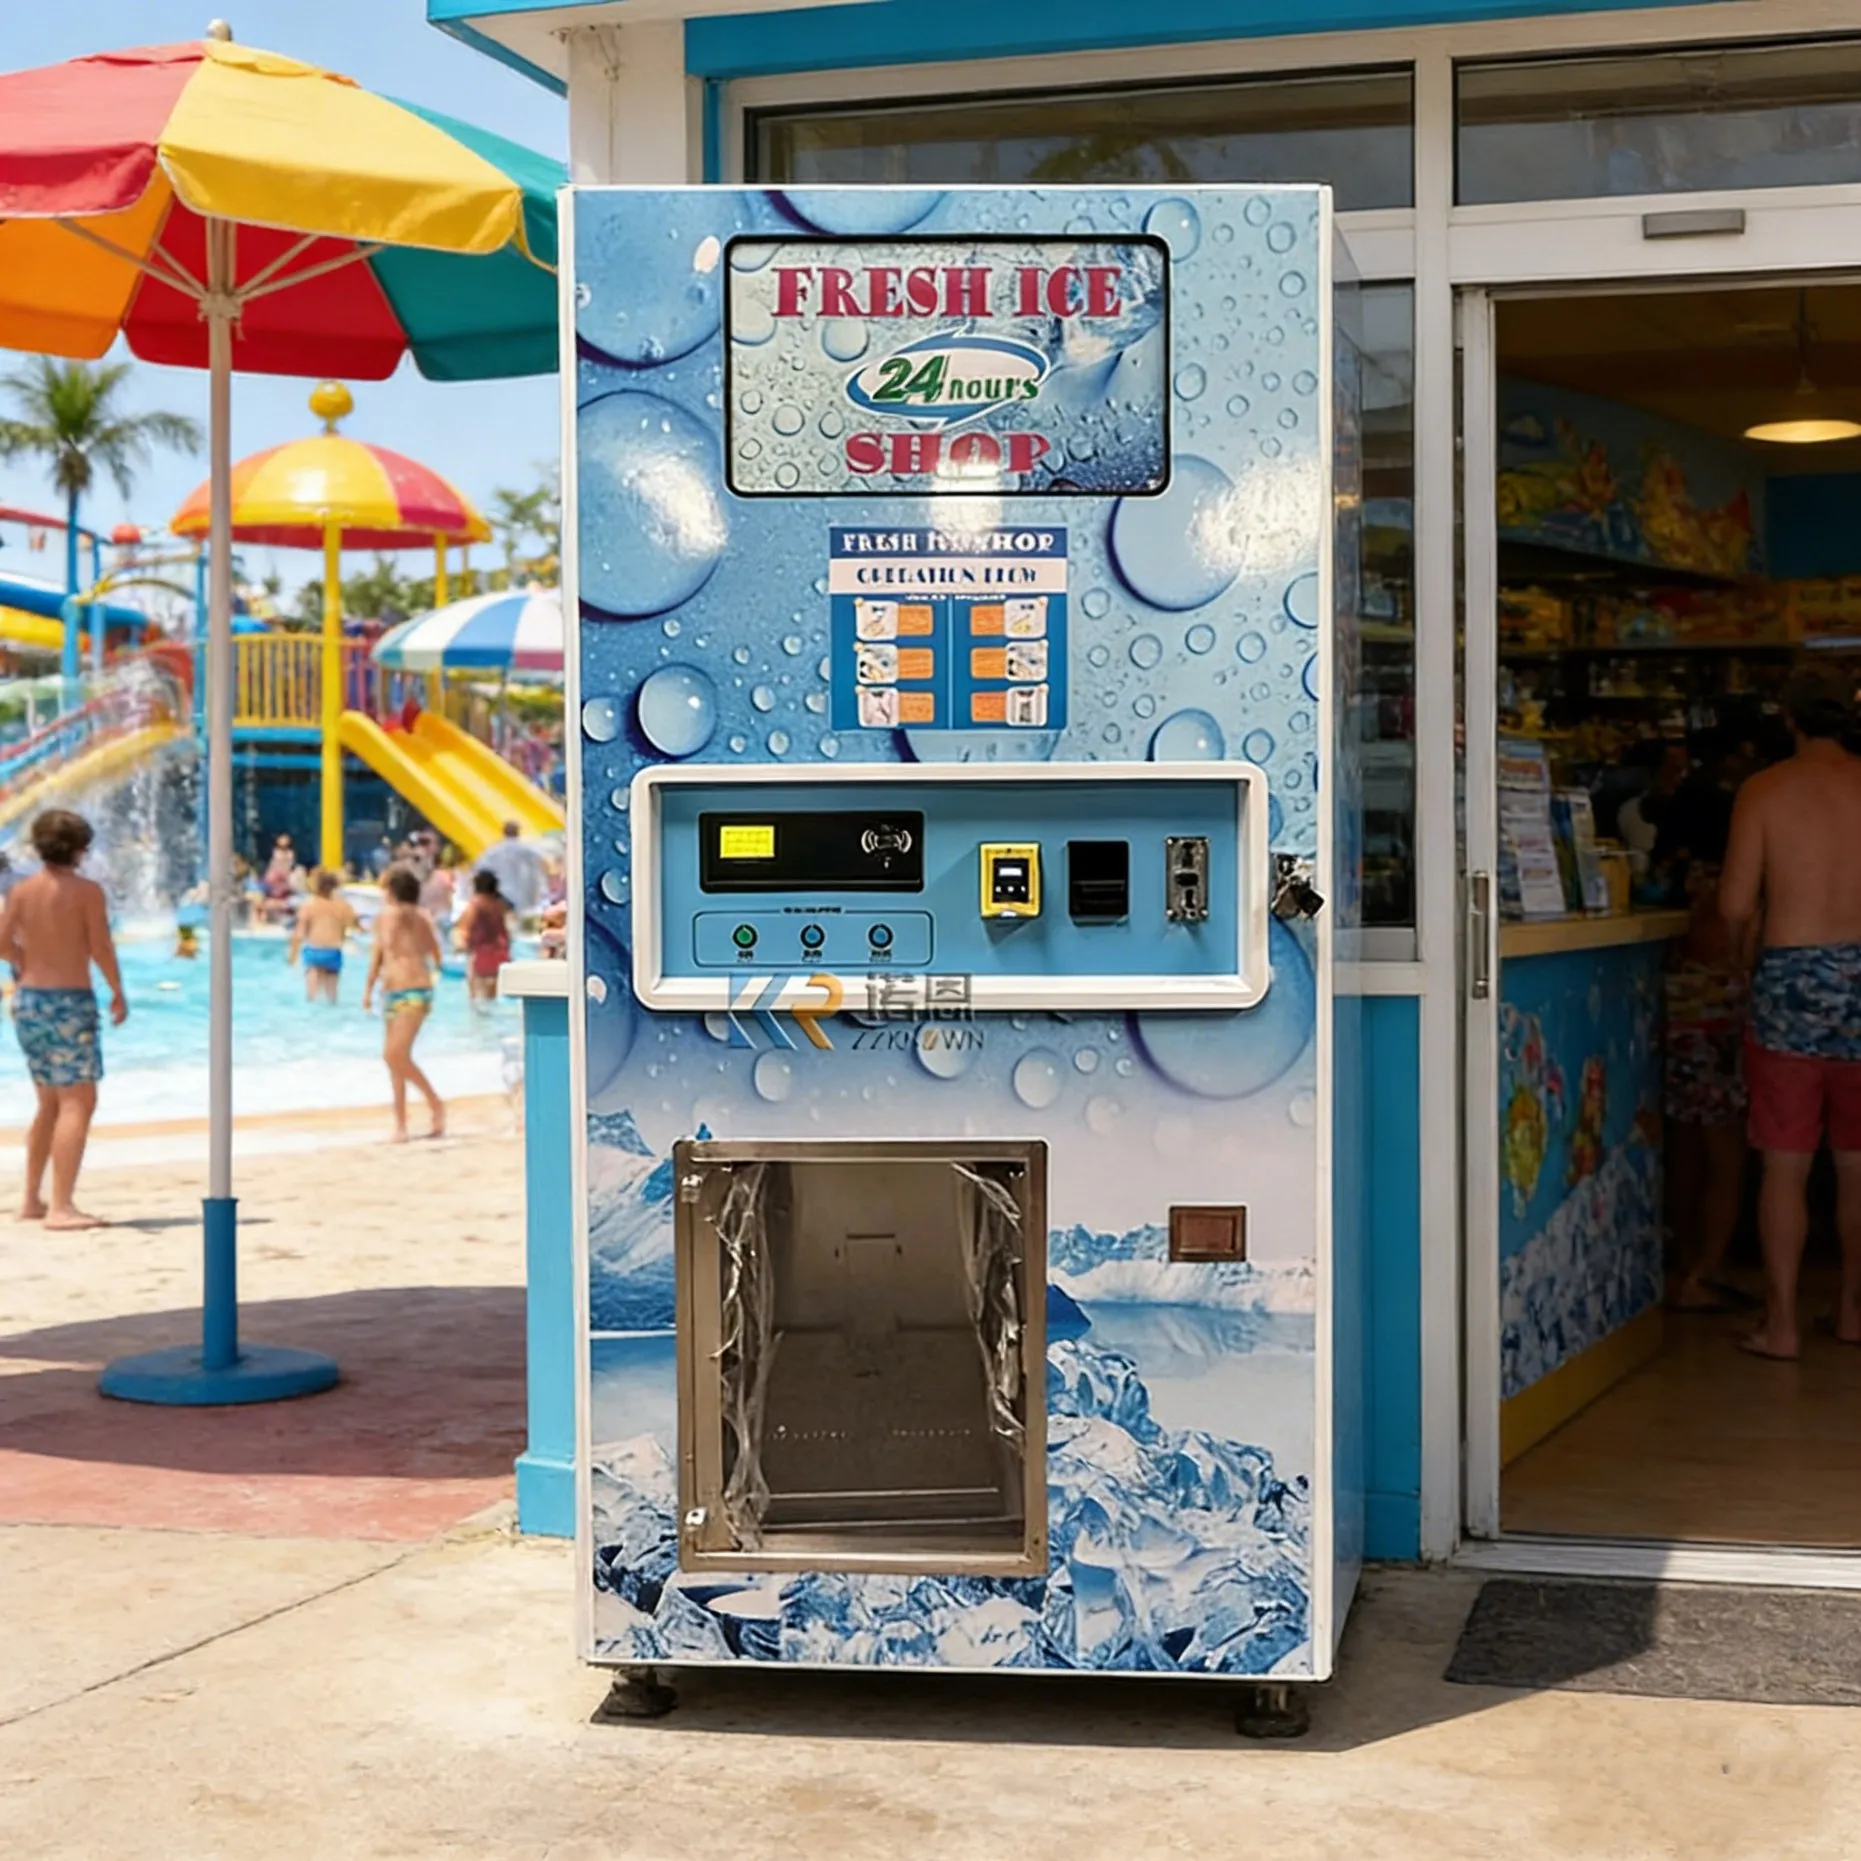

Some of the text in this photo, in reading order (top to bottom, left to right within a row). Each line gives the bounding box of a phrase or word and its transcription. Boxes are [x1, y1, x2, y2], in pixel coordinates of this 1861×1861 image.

[772, 266, 1121, 317] FRESH ICE
[846, 432, 1051, 476] SHOP
